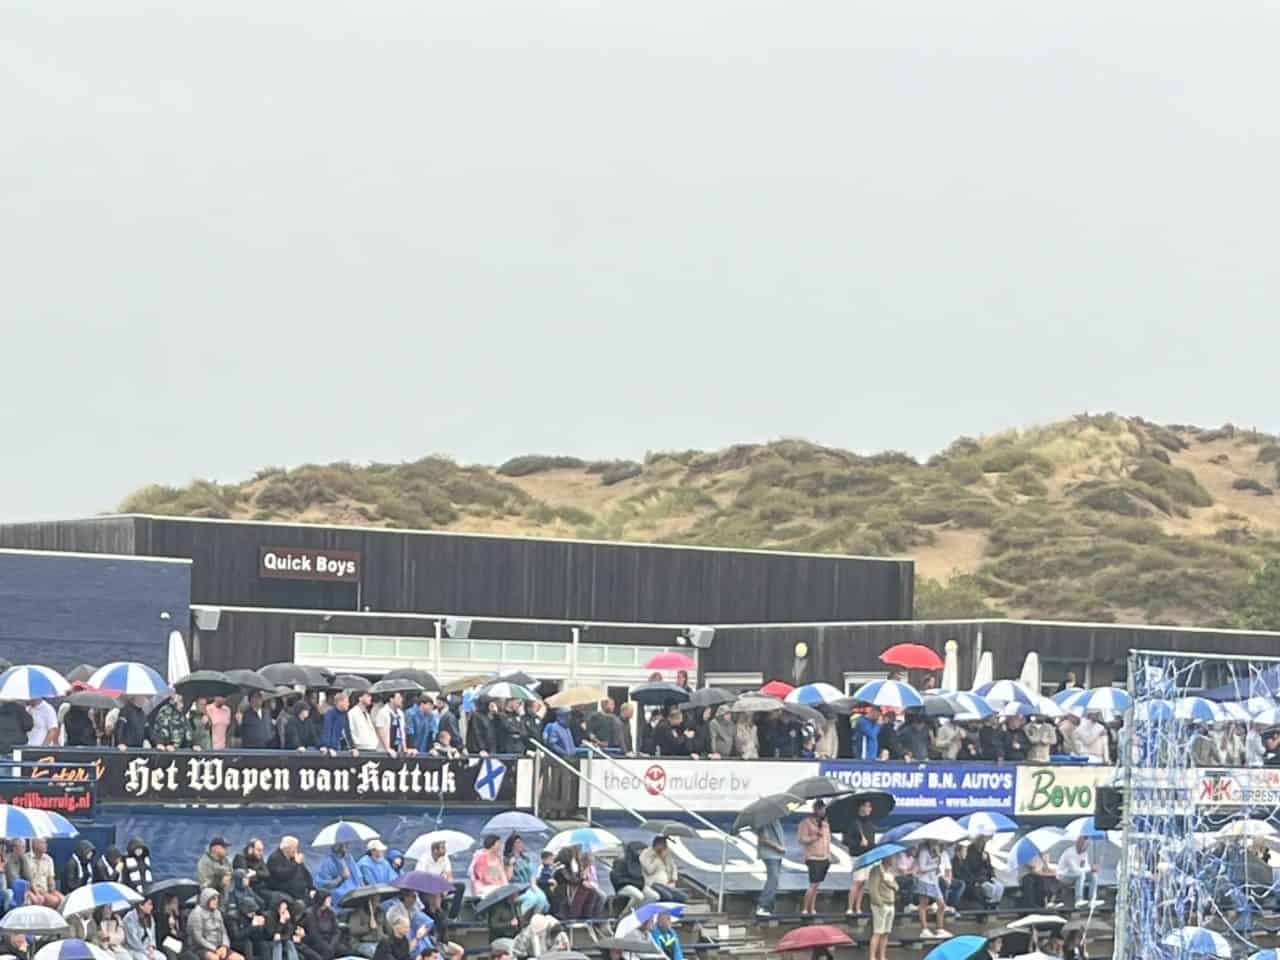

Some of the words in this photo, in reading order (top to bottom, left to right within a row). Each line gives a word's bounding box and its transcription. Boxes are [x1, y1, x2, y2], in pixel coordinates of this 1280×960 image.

[264, 553, 311, 571] Quick
[316, 556, 356, 576] Boys
[124, 757, 179, 796] Het
[186, 758, 290, 796] Wapen
[299, 767, 350, 792] van
[670, 772, 728, 790] mulder
[730, 772, 751, 791] bv
